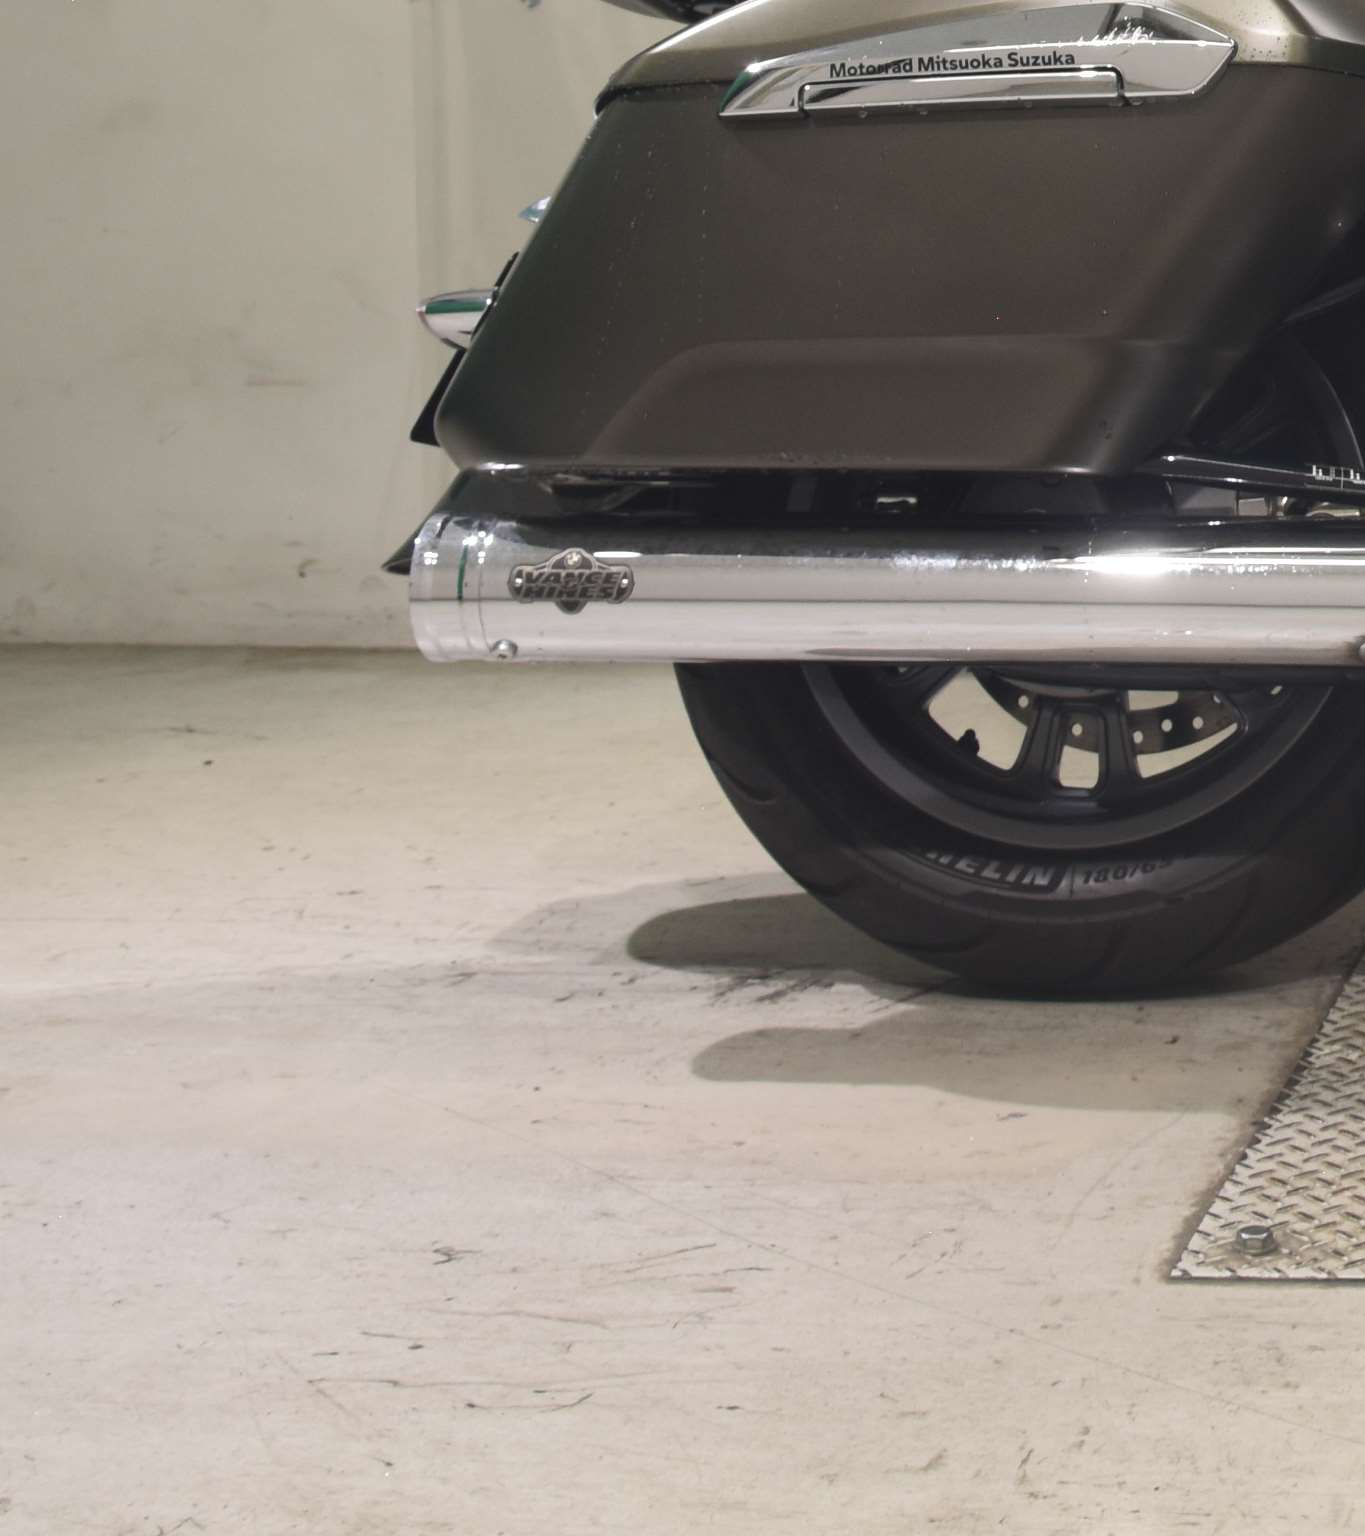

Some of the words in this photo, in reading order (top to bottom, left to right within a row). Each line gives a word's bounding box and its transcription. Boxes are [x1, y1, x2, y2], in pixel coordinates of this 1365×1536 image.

[829, 58, 913, 78] Motorrad
[917, 54, 1003, 72] Mitsuoka
[1007, 51, 1075, 68] Suzuka
